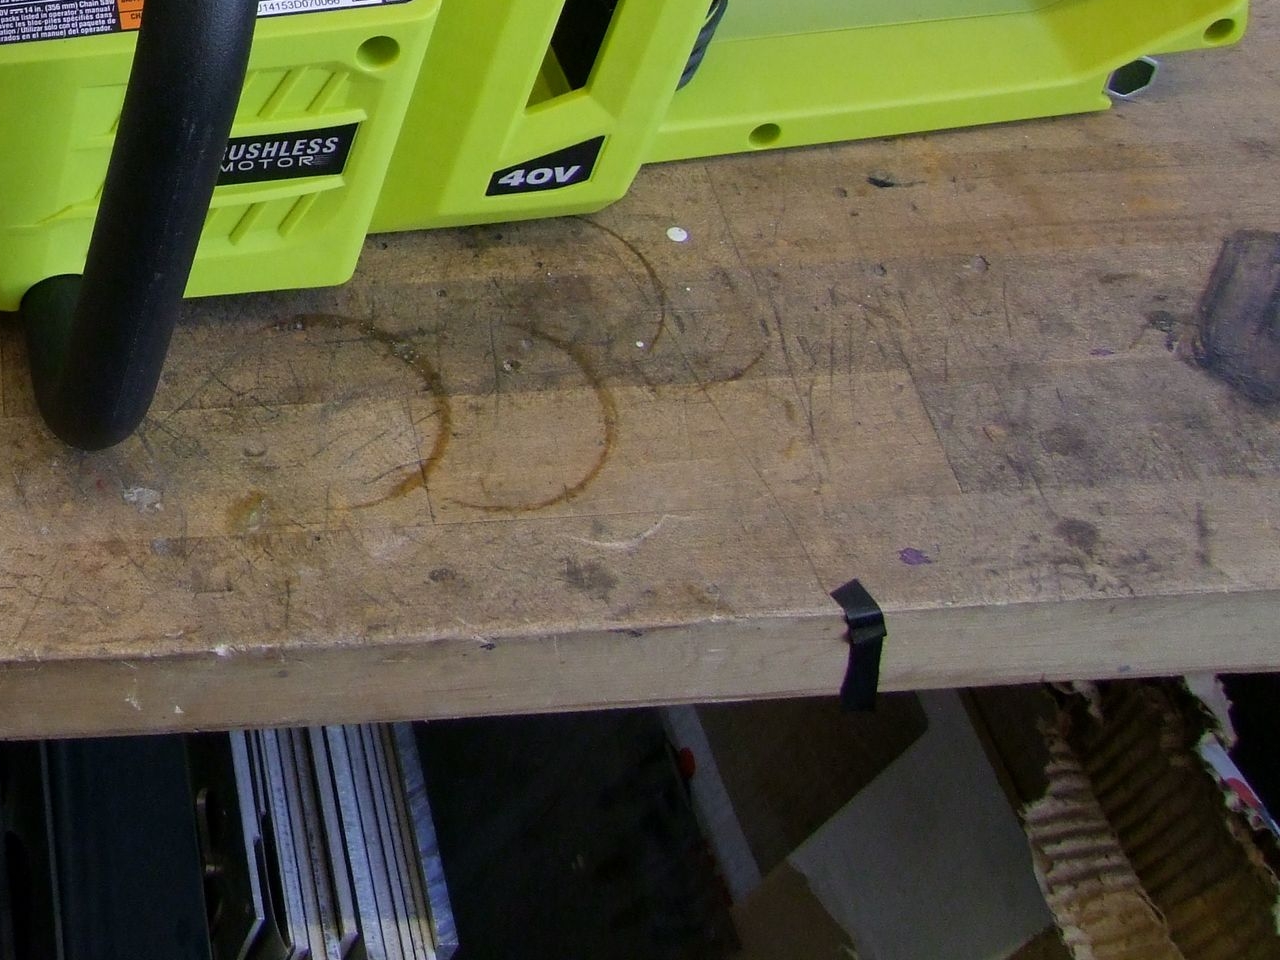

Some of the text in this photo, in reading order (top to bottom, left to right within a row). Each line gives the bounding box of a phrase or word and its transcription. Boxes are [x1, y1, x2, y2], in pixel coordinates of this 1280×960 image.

[61, 1, 78, 10] mm)
[78, 0, 98, 7] Chain
[84, 6, 111, 14] manual
[226, 136, 339, 162] USHLESS
[498, 165, 582, 187] 40V
